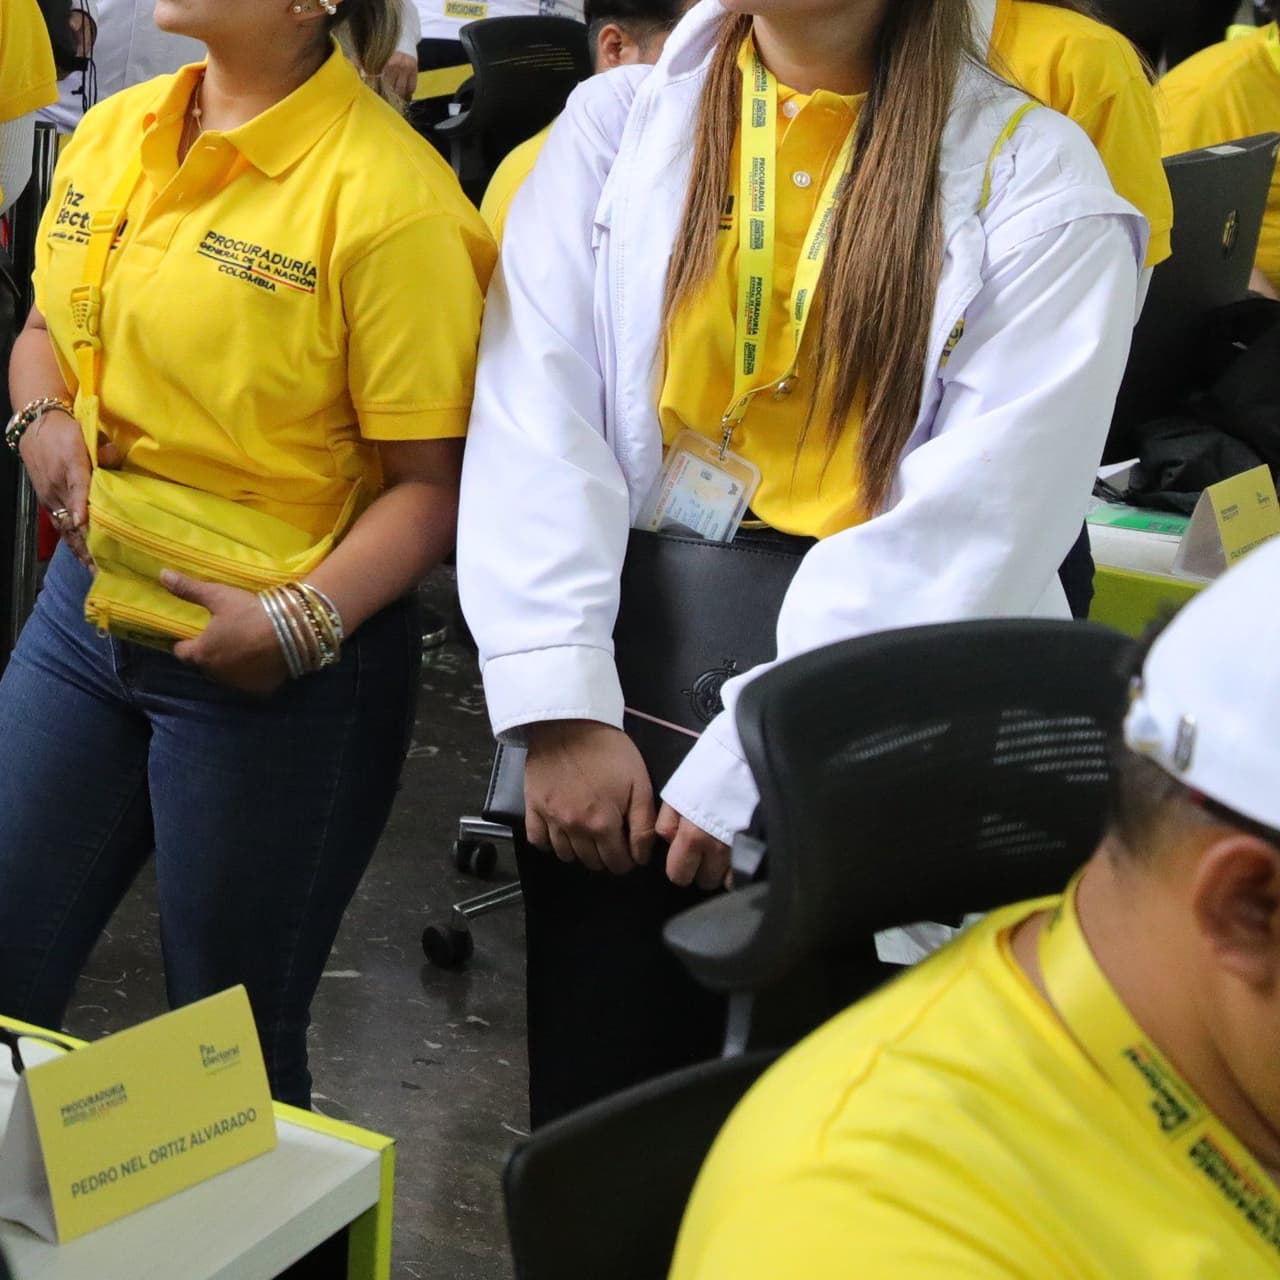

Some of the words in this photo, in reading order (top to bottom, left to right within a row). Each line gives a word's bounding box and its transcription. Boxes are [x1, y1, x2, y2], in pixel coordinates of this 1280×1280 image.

[758, 157, 766, 212] PROCURADURÍA
[200, 241, 240, 265] GENERAL
[242, 255, 255, 267] DE
[257, 260, 272, 272] LA
[274, 266, 316, 288] NACIÓN
[204, 231, 317, 279] PROCURADURÍA
[218, 264, 276, 292] COLOMBIA
[753, 277, 763, 335] PROCURADURÍA
[71, 1167, 118, 1199] PEDRO
[120, 1155, 146, 1177] NEL
[149, 1136, 187, 1164] ORTIZ
[190, 1107, 257, 1149] ALVARADO
